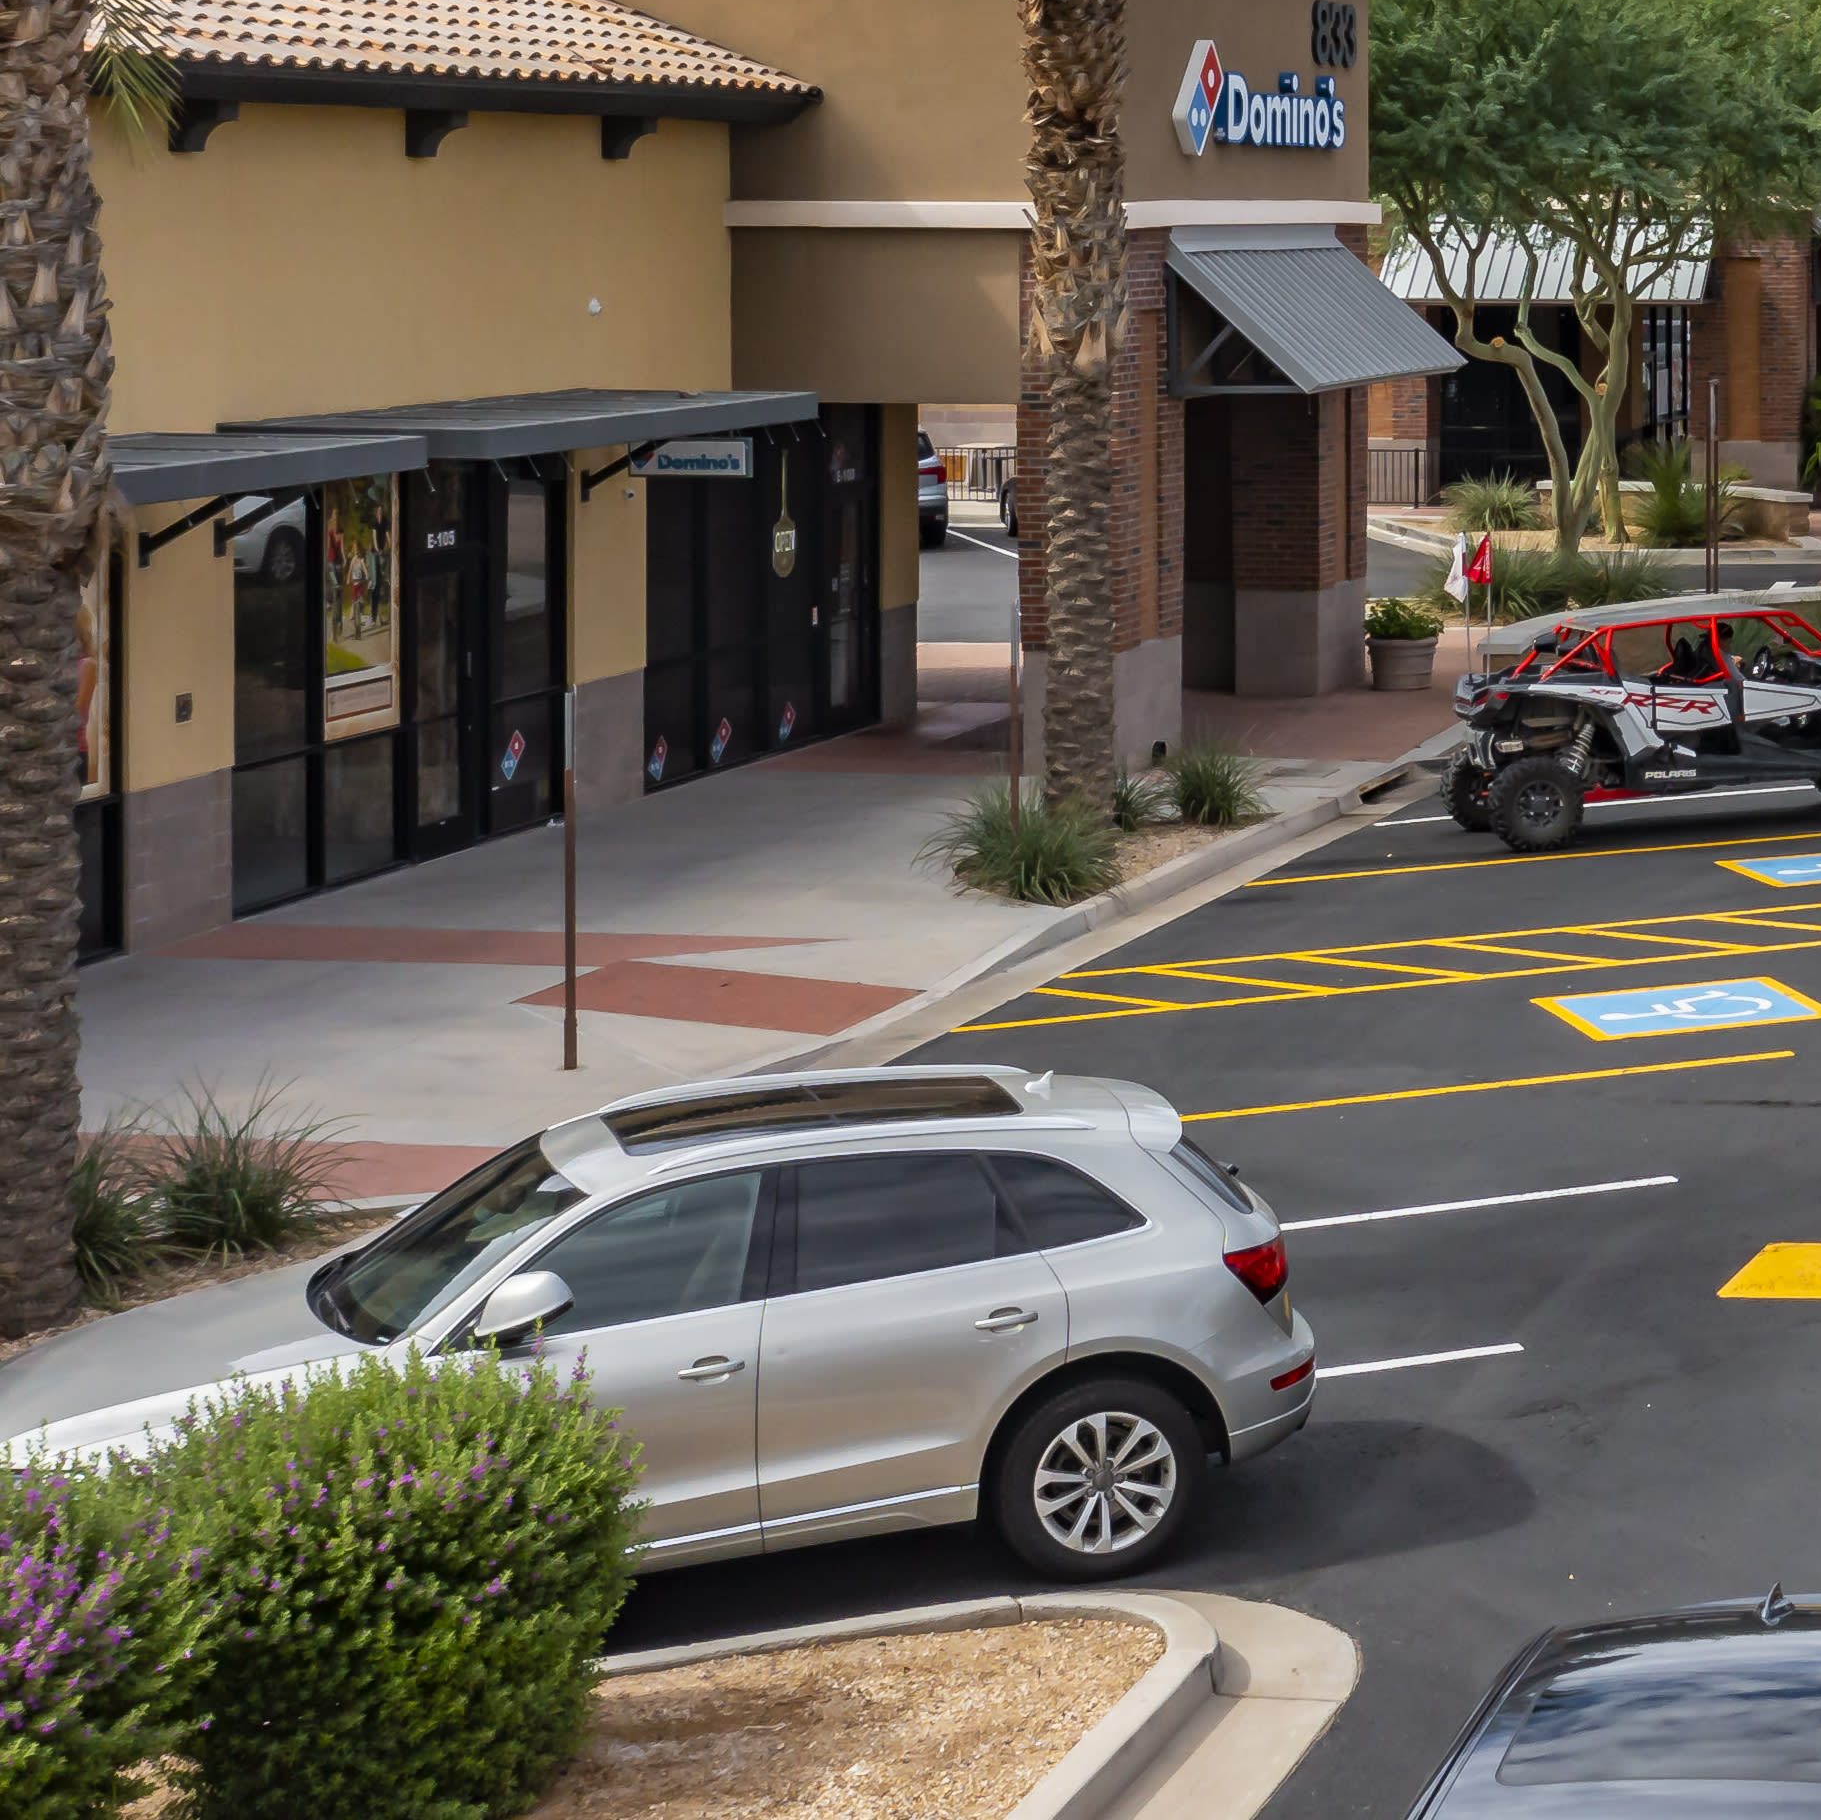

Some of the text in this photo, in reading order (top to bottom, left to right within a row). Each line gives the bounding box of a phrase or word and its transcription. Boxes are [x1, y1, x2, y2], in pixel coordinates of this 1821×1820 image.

[1312, 0, 1357, 68] 833
[1226, 71, 1346, 149] Domino's
[657, 453, 740, 470] Domino's
[427, 530, 455, 549] E-105
[1587, 688, 1623, 696] XP
[1621, 692, 1719, 715] RZR
[1644, 769, 1698, 780] POLARIS
